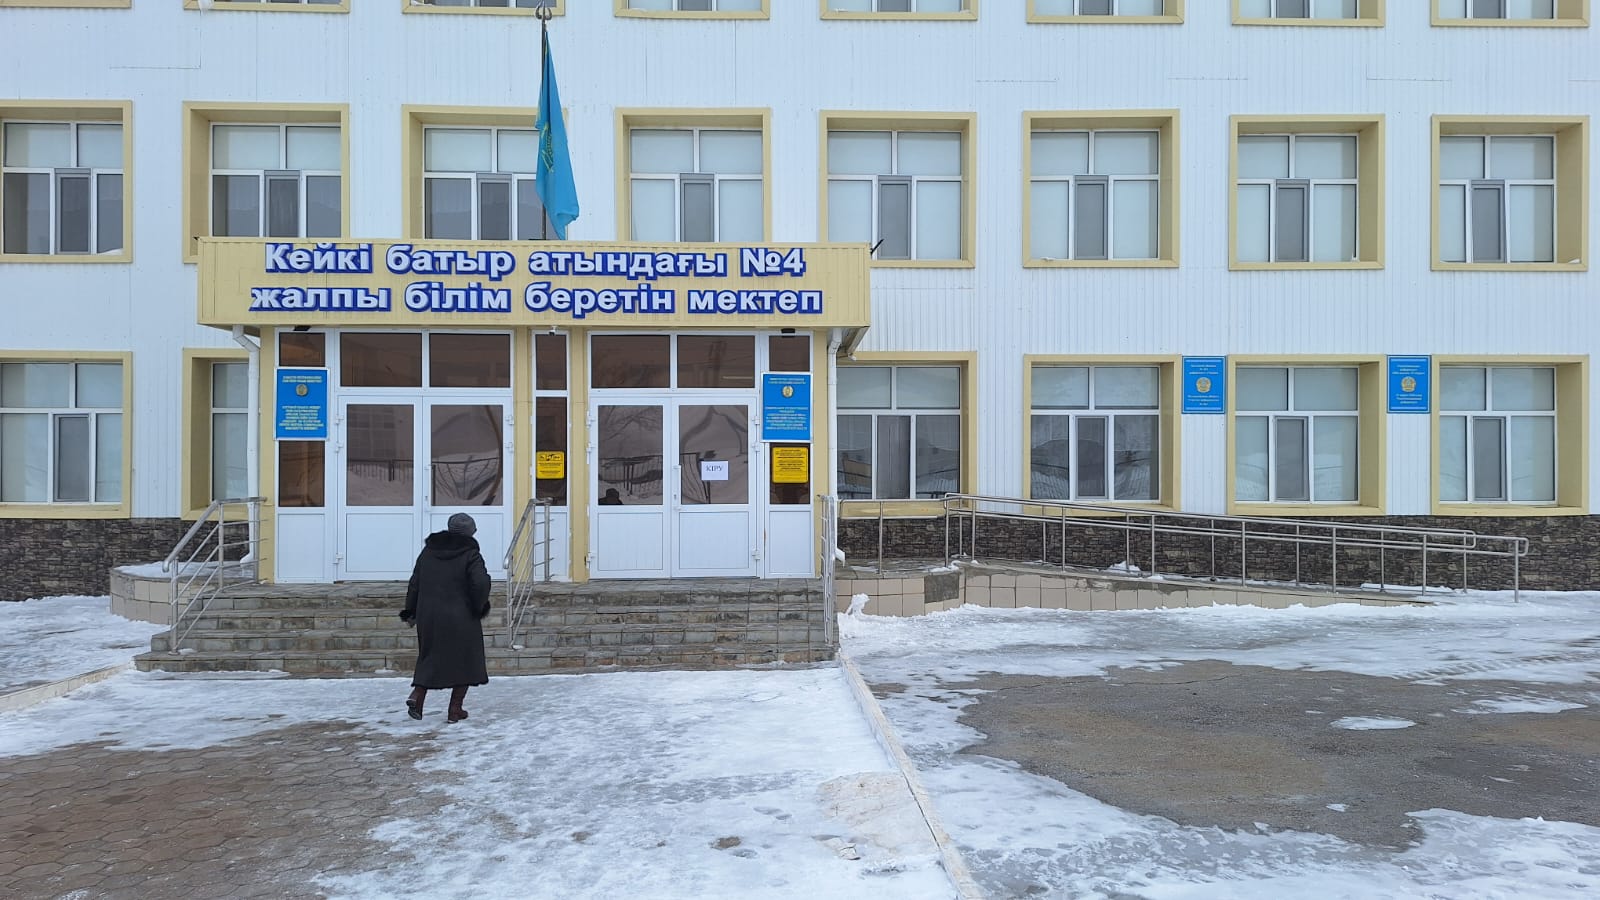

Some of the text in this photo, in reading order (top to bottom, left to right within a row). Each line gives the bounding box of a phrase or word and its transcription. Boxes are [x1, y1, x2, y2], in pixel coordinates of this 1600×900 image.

[265, 243, 806, 281] Кейкі батыр атындағы №4
[249, 281, 822, 318] жалпы білім беретін мектеп
